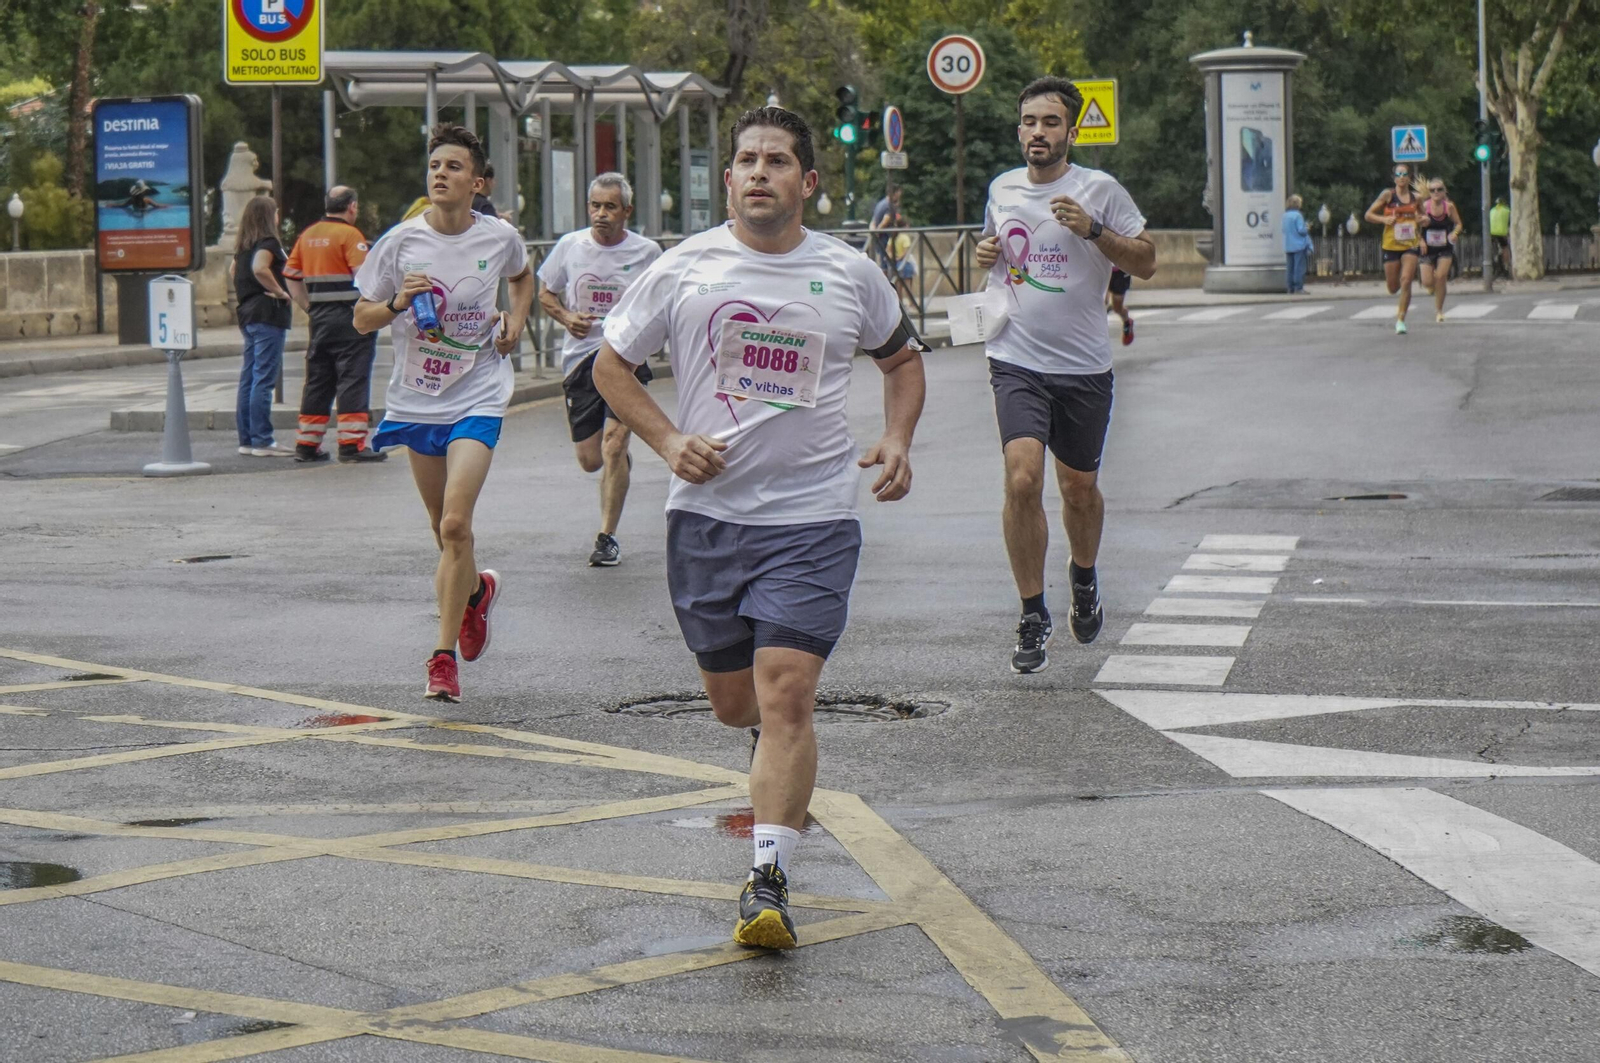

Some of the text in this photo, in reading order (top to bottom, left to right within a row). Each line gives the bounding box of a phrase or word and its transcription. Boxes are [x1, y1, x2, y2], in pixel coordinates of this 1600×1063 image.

[259, 14, 287, 24] BUS
[241, 49, 306, 61] SOLO BUS
[232, 65, 316, 75] METROPOLITANO
[941, 55, 971, 73] 30
[1246, 210, 1269, 228] 0€
[308, 238, 330, 247] TES
[1041, 264, 1061, 272] 5415
[592, 292, 612, 303] 809
[158, 313, 190, 344] 5 km
[458, 322, 478, 330] 5415
[740, 331, 806, 348] COVIRAN
[418, 346, 462, 360] COVIRAN
[742, 344, 799, 374] 8088
[422, 358, 451, 375] 434
[755, 382, 794, 396] vithas
[758, 840, 775, 848] UP
